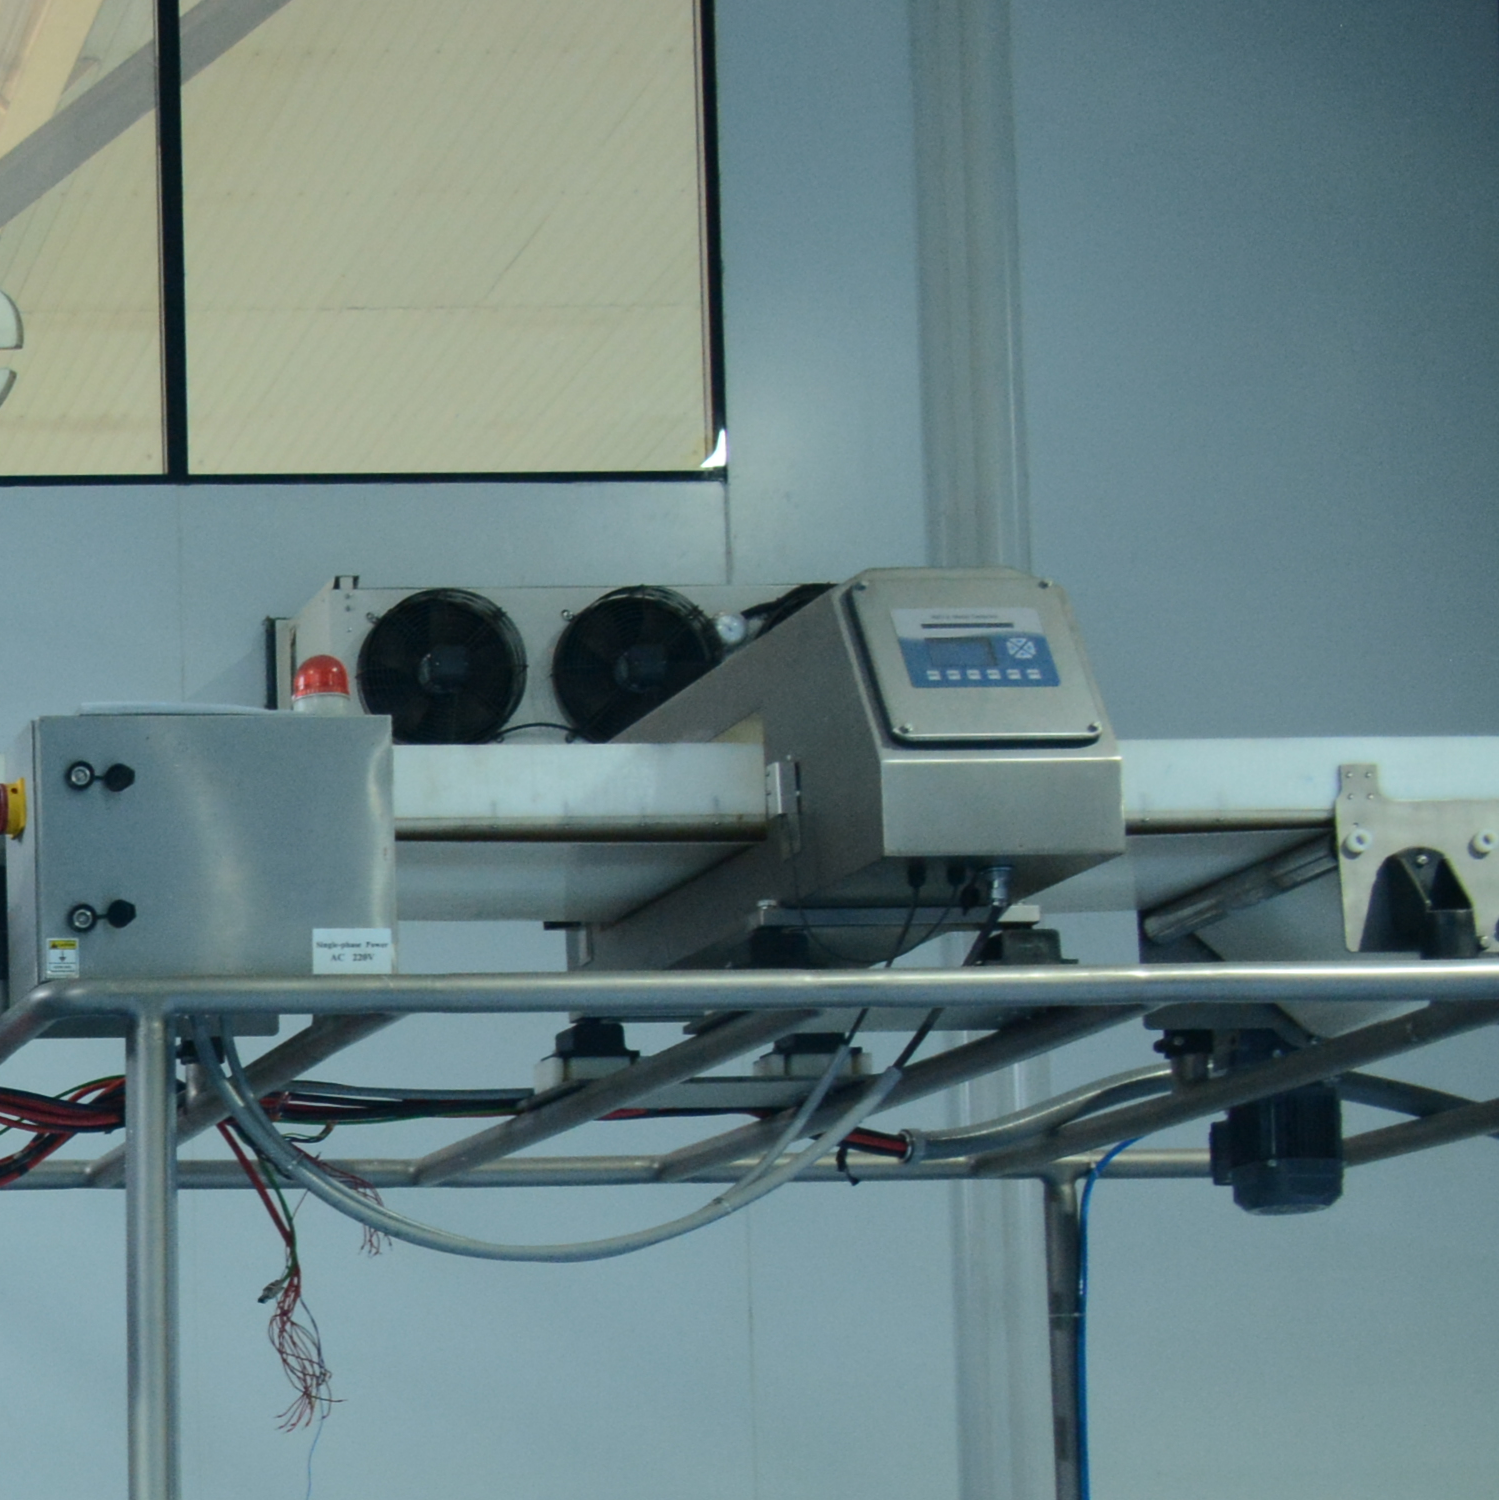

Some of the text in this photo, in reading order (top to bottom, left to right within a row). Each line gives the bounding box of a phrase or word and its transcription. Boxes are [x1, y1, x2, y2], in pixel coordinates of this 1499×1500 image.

[366, 941, 389, 949] Power
[331, 953, 375, 961] AC 220V
